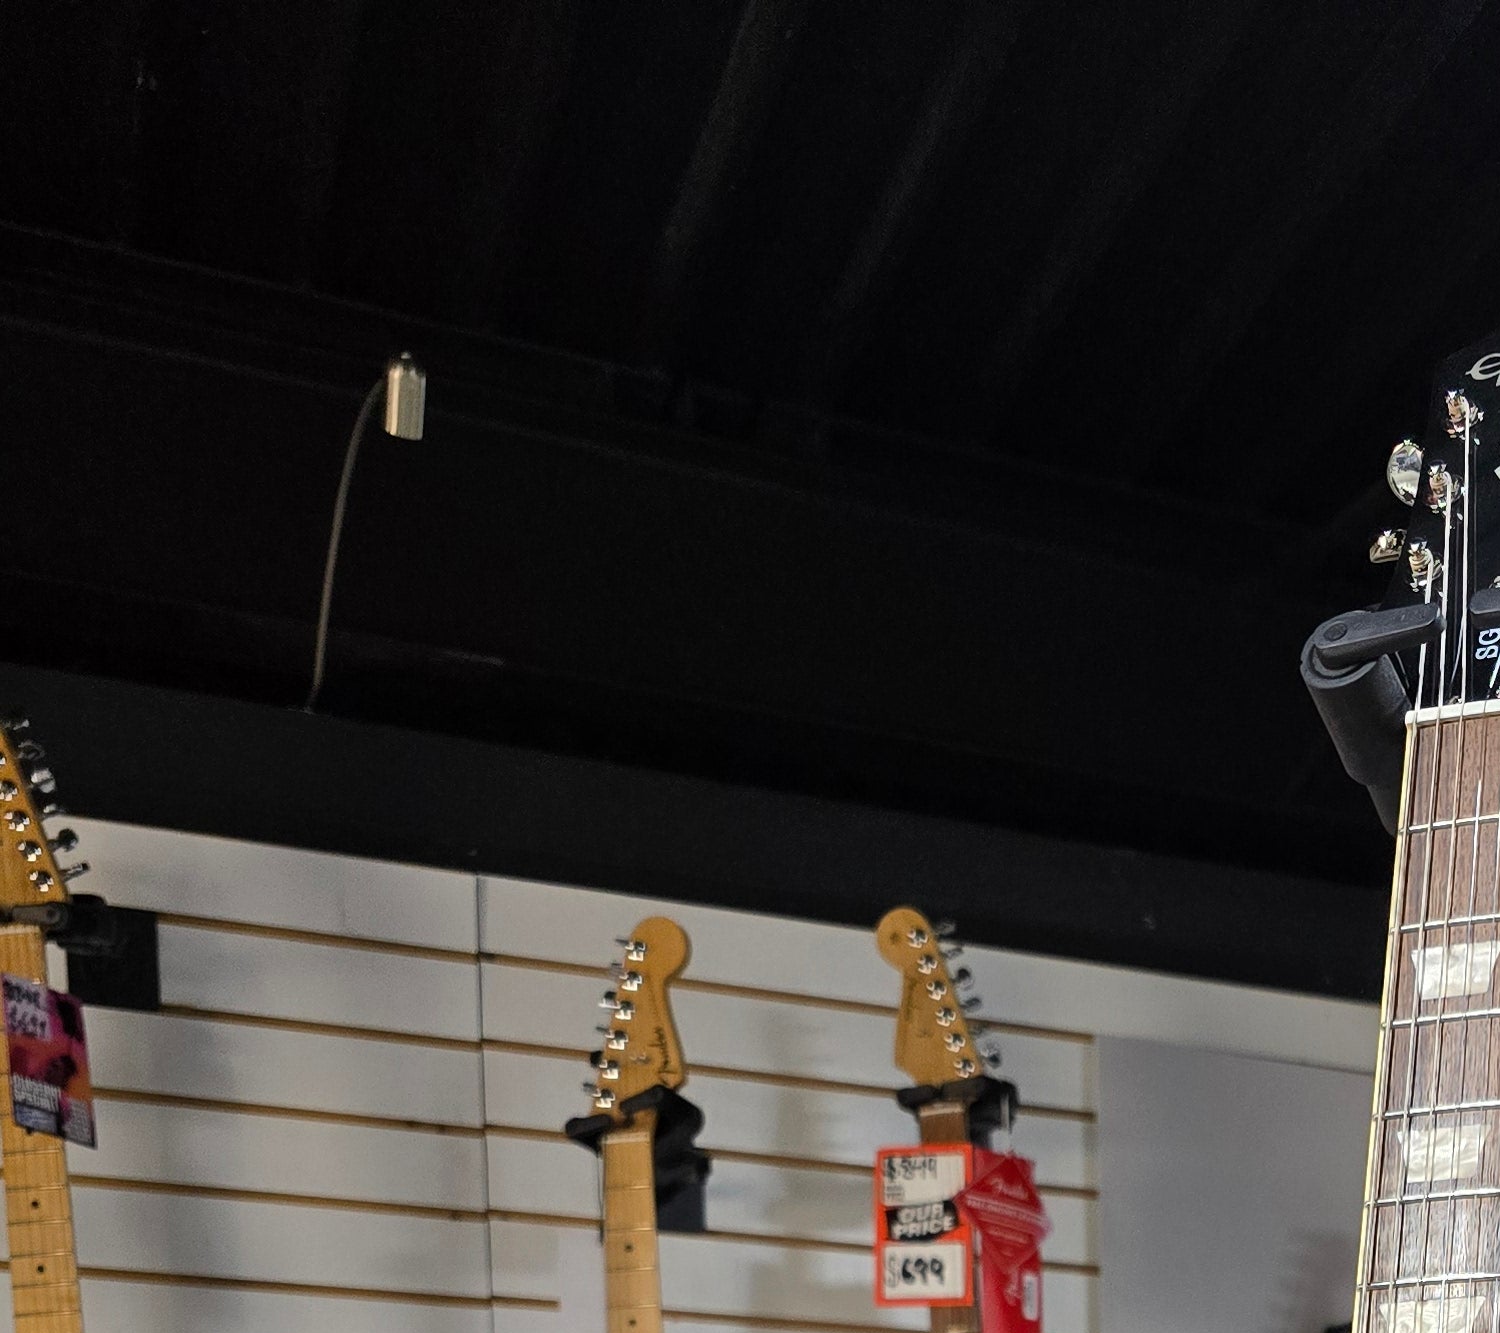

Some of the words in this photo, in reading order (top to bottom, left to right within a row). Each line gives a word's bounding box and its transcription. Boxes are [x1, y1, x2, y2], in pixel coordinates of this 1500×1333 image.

[899, 1205, 945, 1224] OUR
[892, 1216, 956, 1239] PRICE
[886, 1254, 946, 1287] $699
